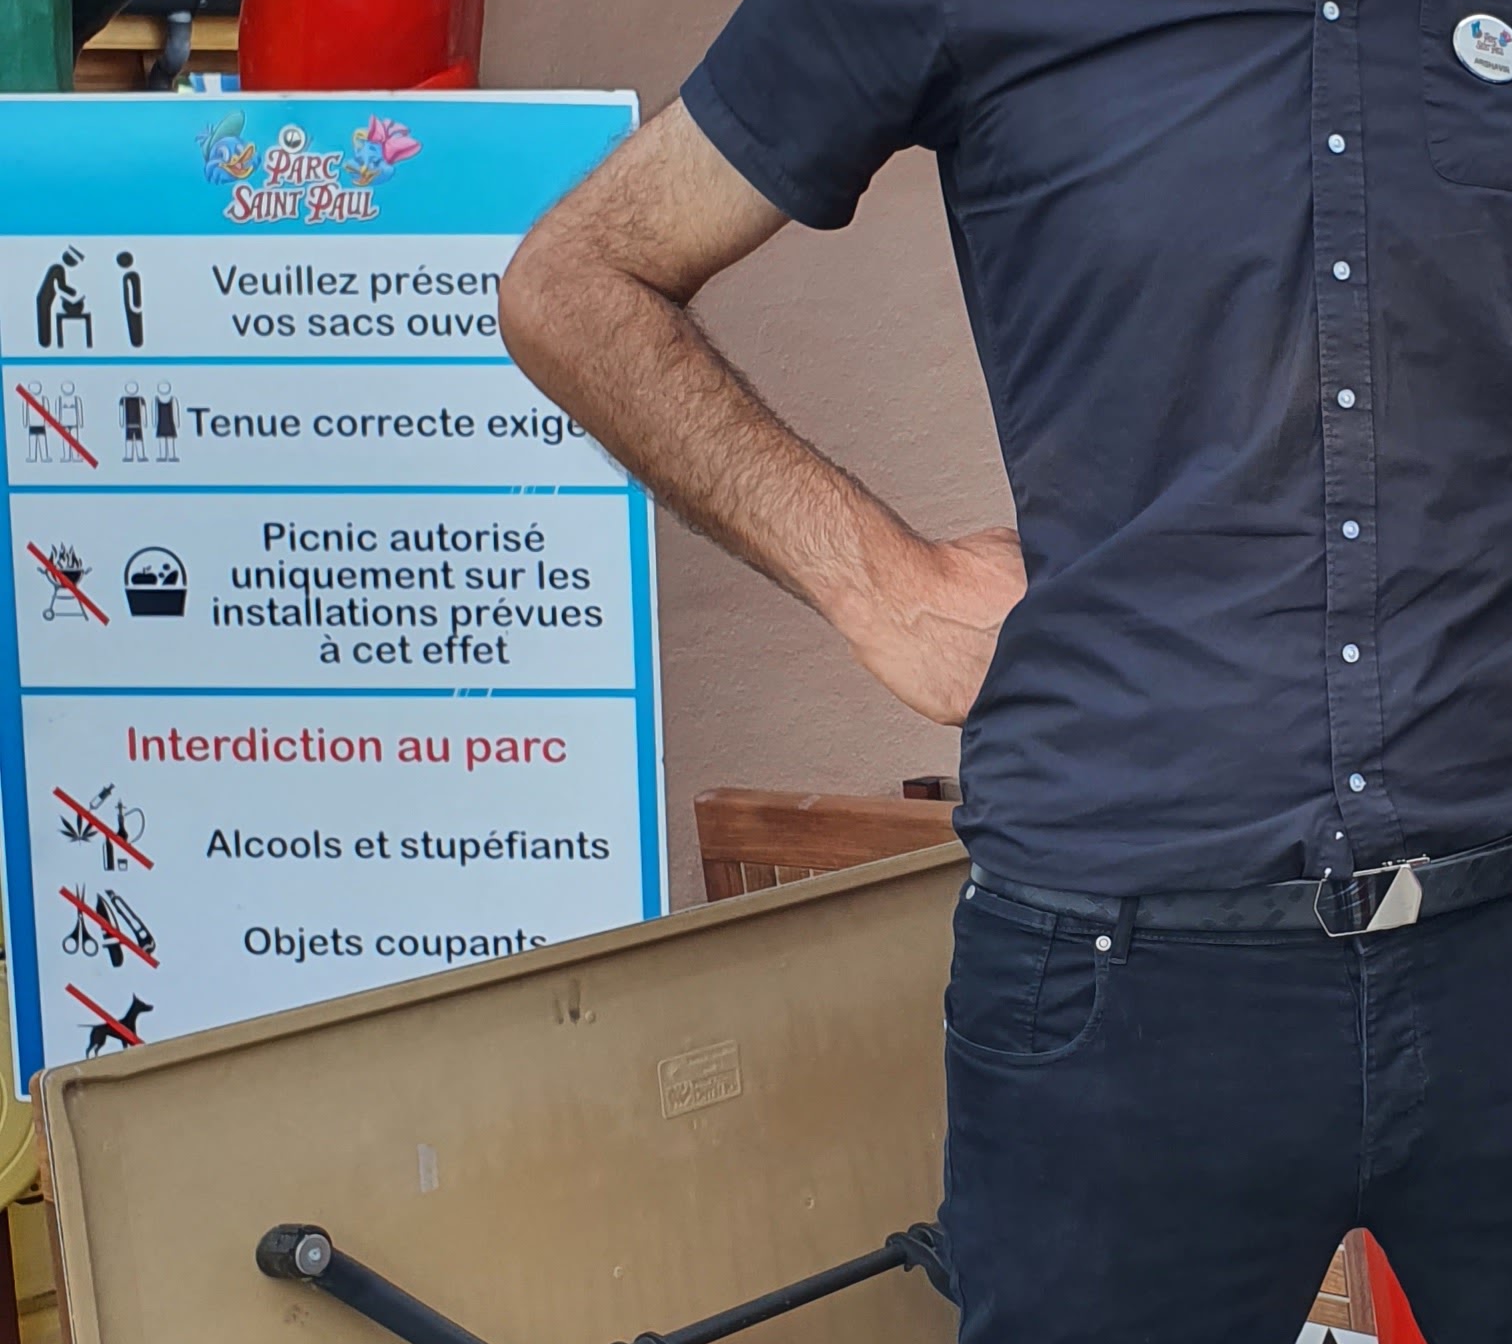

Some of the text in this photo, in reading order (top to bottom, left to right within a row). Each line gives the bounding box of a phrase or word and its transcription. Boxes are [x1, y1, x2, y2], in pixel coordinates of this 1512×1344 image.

[213, 266, 500, 301] Veuillez présen
[233, 314, 497, 337] vos sacs ouve
[187, 407, 300, 437] Tenue
[313, 407, 475, 437] correcte
[263, 522, 545, 552] Picnic autorisé
[231, 560, 590, 599] uniquement sur les
[213, 597, 603, 638] installations prévues
[320, 633, 510, 664] à cet effet
[127, 727, 566, 771] Interdiction au parc
[206, 829, 610, 867] Alcools et stupéfiants
[244, 926, 363, 963] Objets
